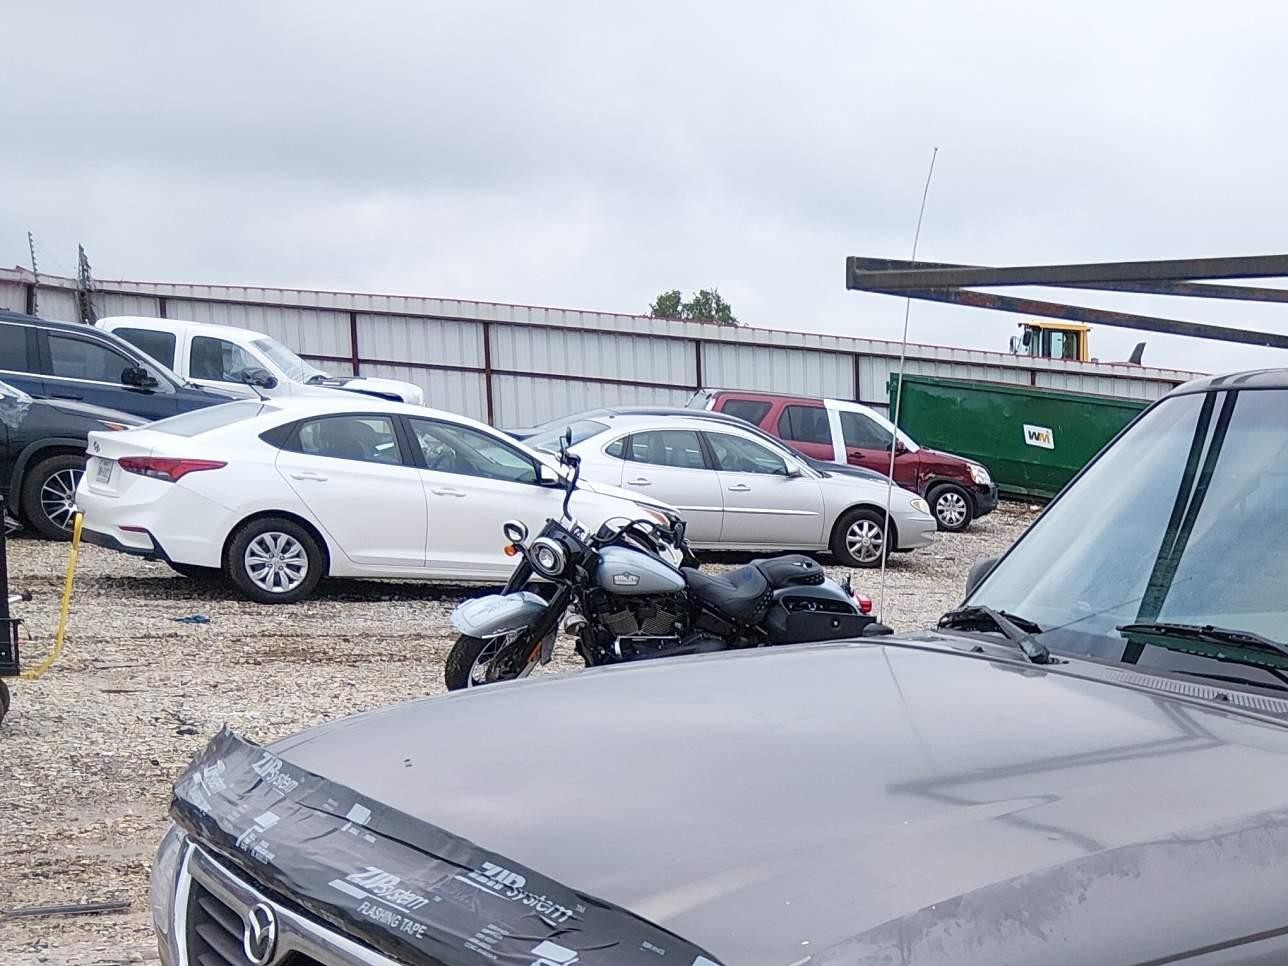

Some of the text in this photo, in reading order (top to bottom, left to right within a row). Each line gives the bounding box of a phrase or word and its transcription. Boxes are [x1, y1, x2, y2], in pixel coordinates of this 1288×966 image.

[1028, 429, 1050, 444] WM
[357, 901, 428, 939] FLASHING TAPE
